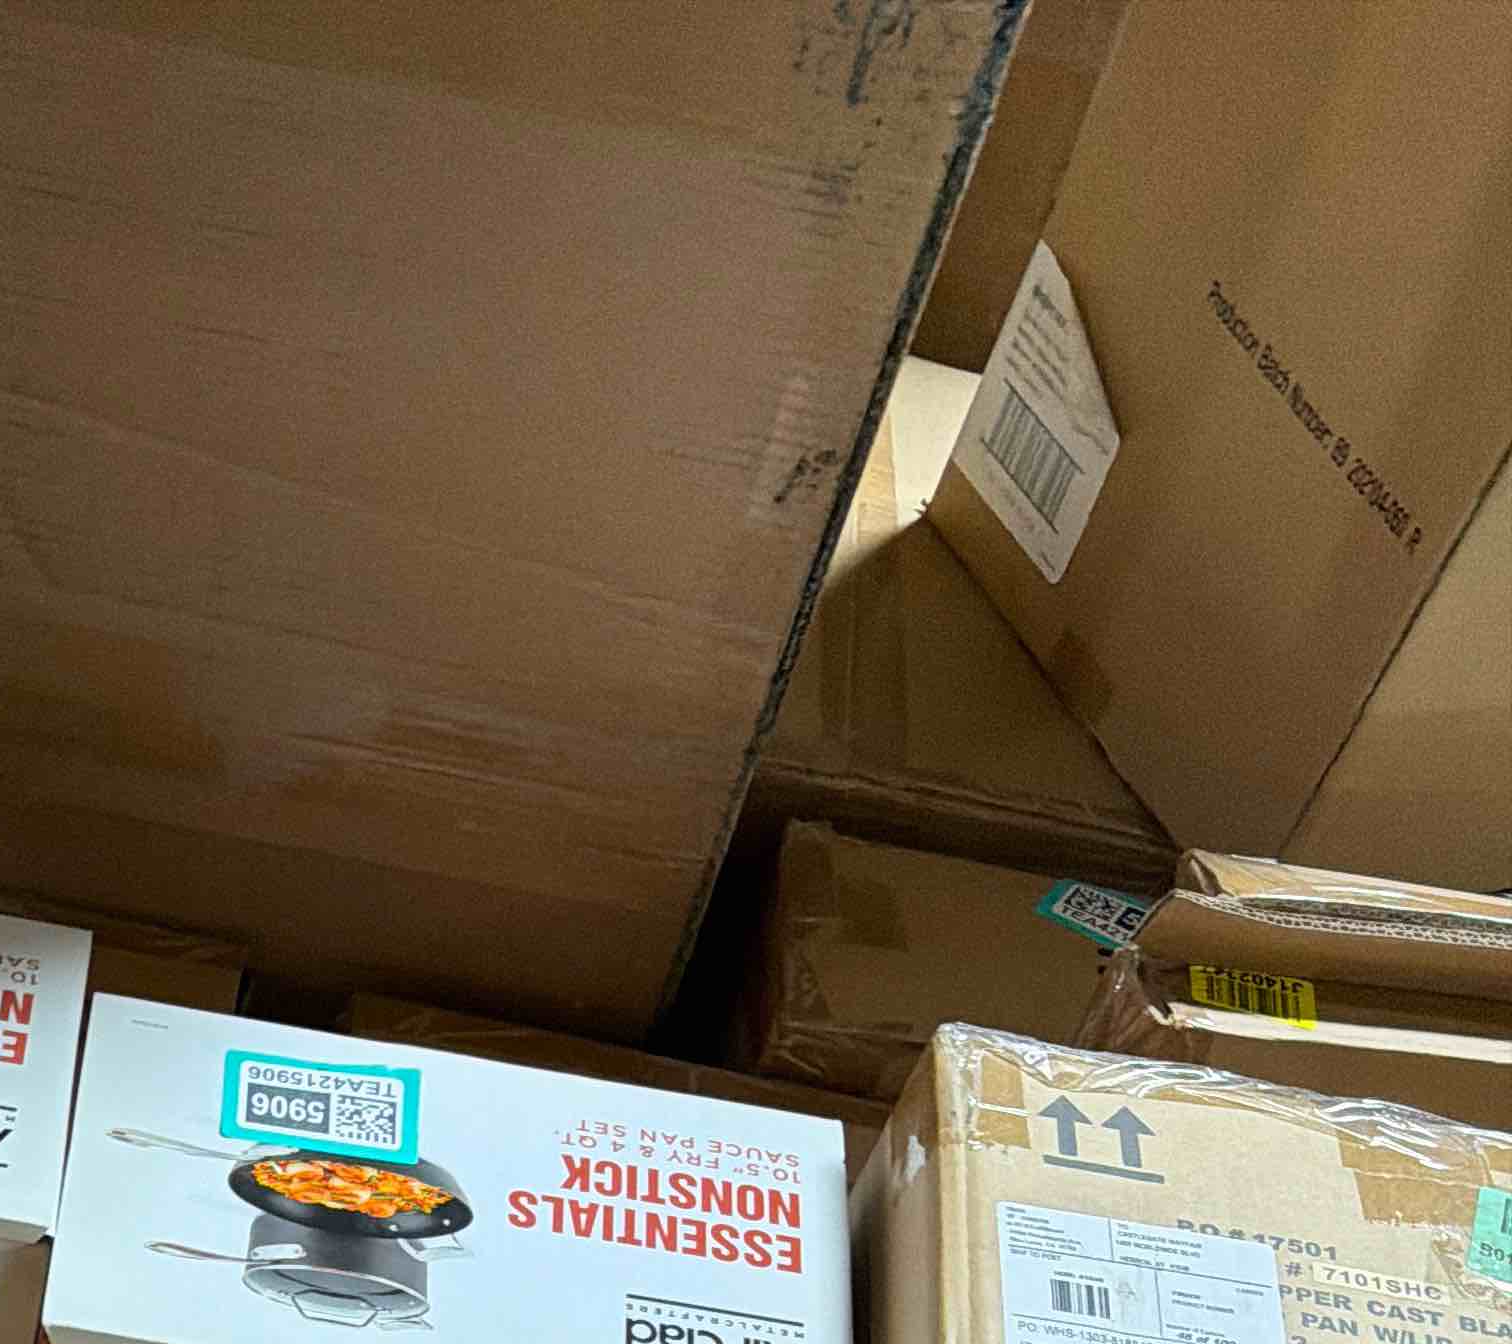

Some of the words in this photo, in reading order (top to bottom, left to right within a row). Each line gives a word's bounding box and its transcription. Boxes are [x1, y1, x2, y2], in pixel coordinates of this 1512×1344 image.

[247, 1065, 397, 1098] TEA4215906
[250, 1091, 326, 1125] 5906
[575, 1119, 626, 1137] SET
[640, 1128, 695, 1150] PAN
[611, 1140, 624, 1153] 4
[639, 1144, 655, 1158] &
[708, 1139, 800, 1168] SAUCE
[667, 1150, 720, 1170] FRY
[561, 1153, 801, 1229] NONSTICK
[507, 1190, 803, 1274] ESSENTIALS
[1254, 1234, 1338, 1260] 17501
[1323, 1267, 1442, 1300] 7101SHC
[1301, 1312, 1359, 1336] PAN
[1367, 1300, 1444, 1326] CAST
